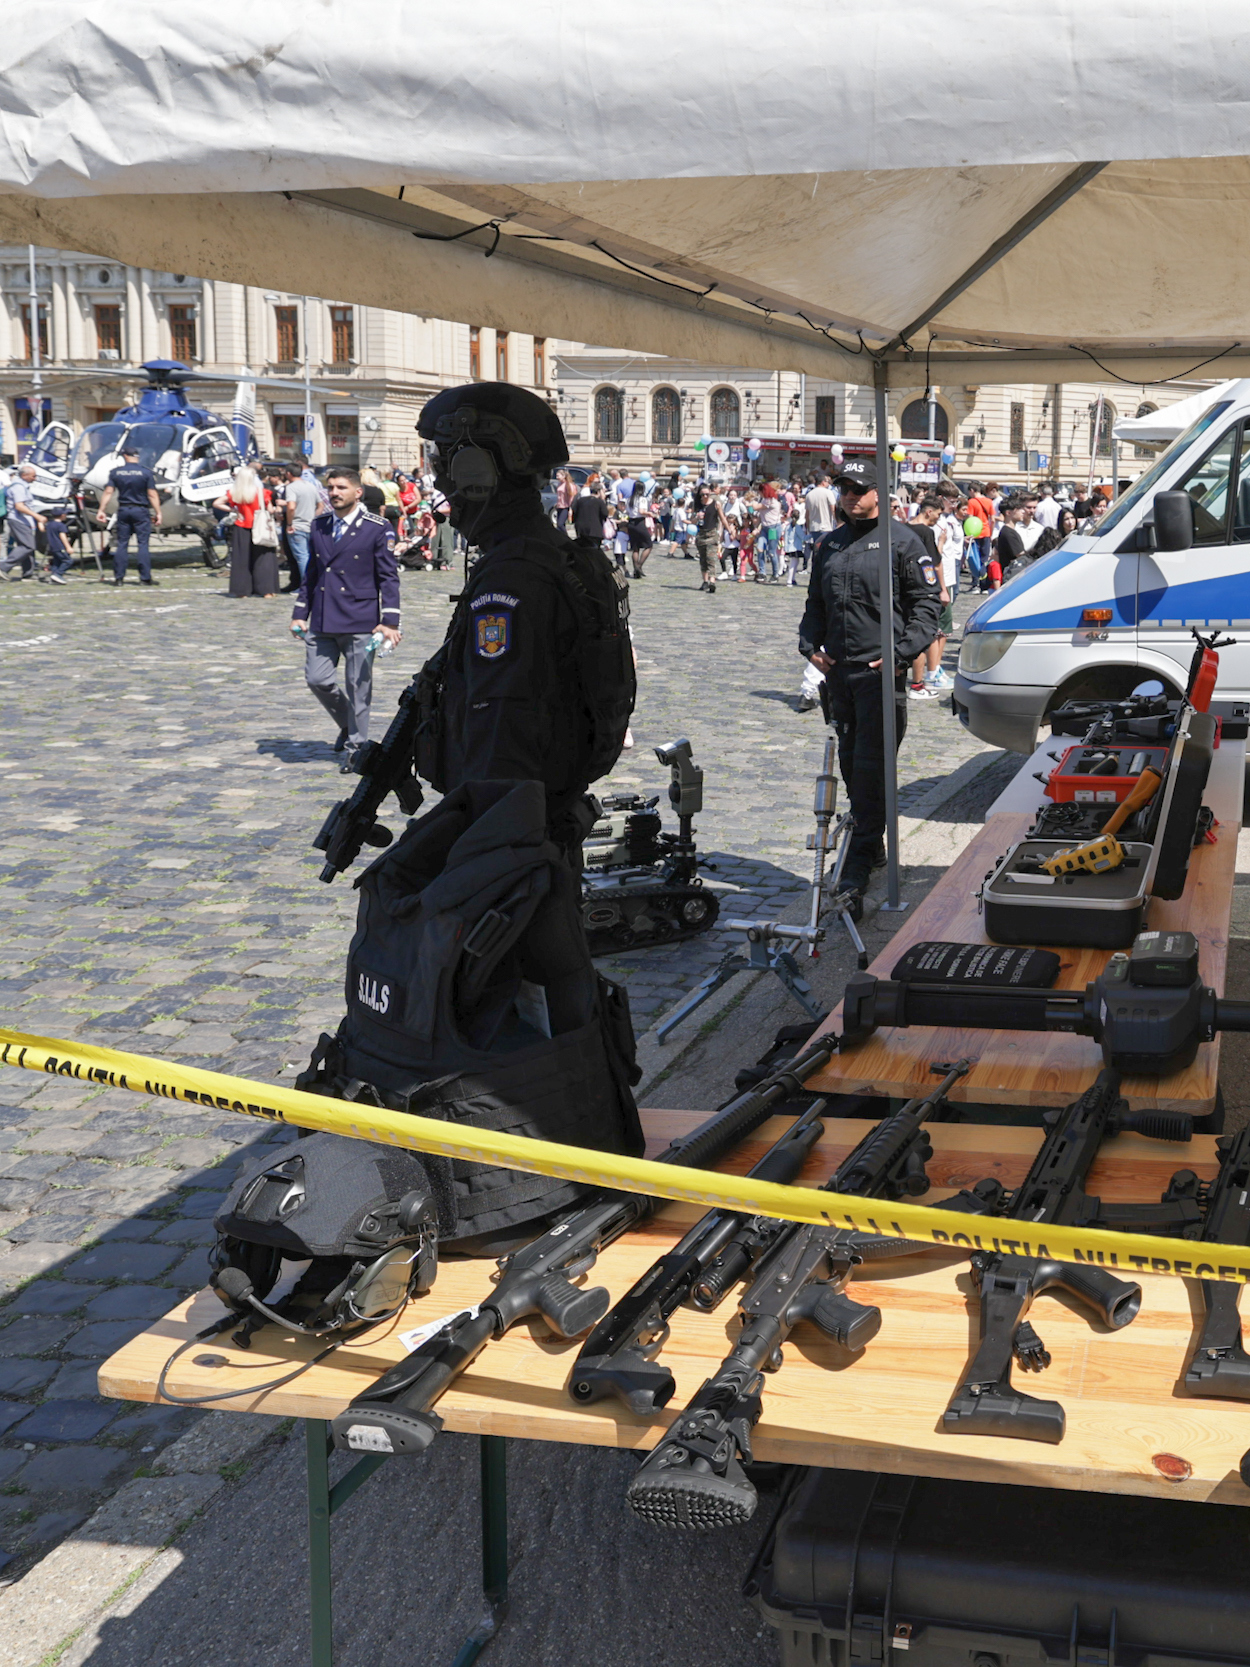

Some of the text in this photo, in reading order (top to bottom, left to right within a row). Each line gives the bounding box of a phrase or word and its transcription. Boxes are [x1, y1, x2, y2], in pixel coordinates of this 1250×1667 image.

[843, 463, 865, 473] SIAS
[993, 959, 1008, 975] FACE
[359, 973, 390, 1014] S.I.A.S
